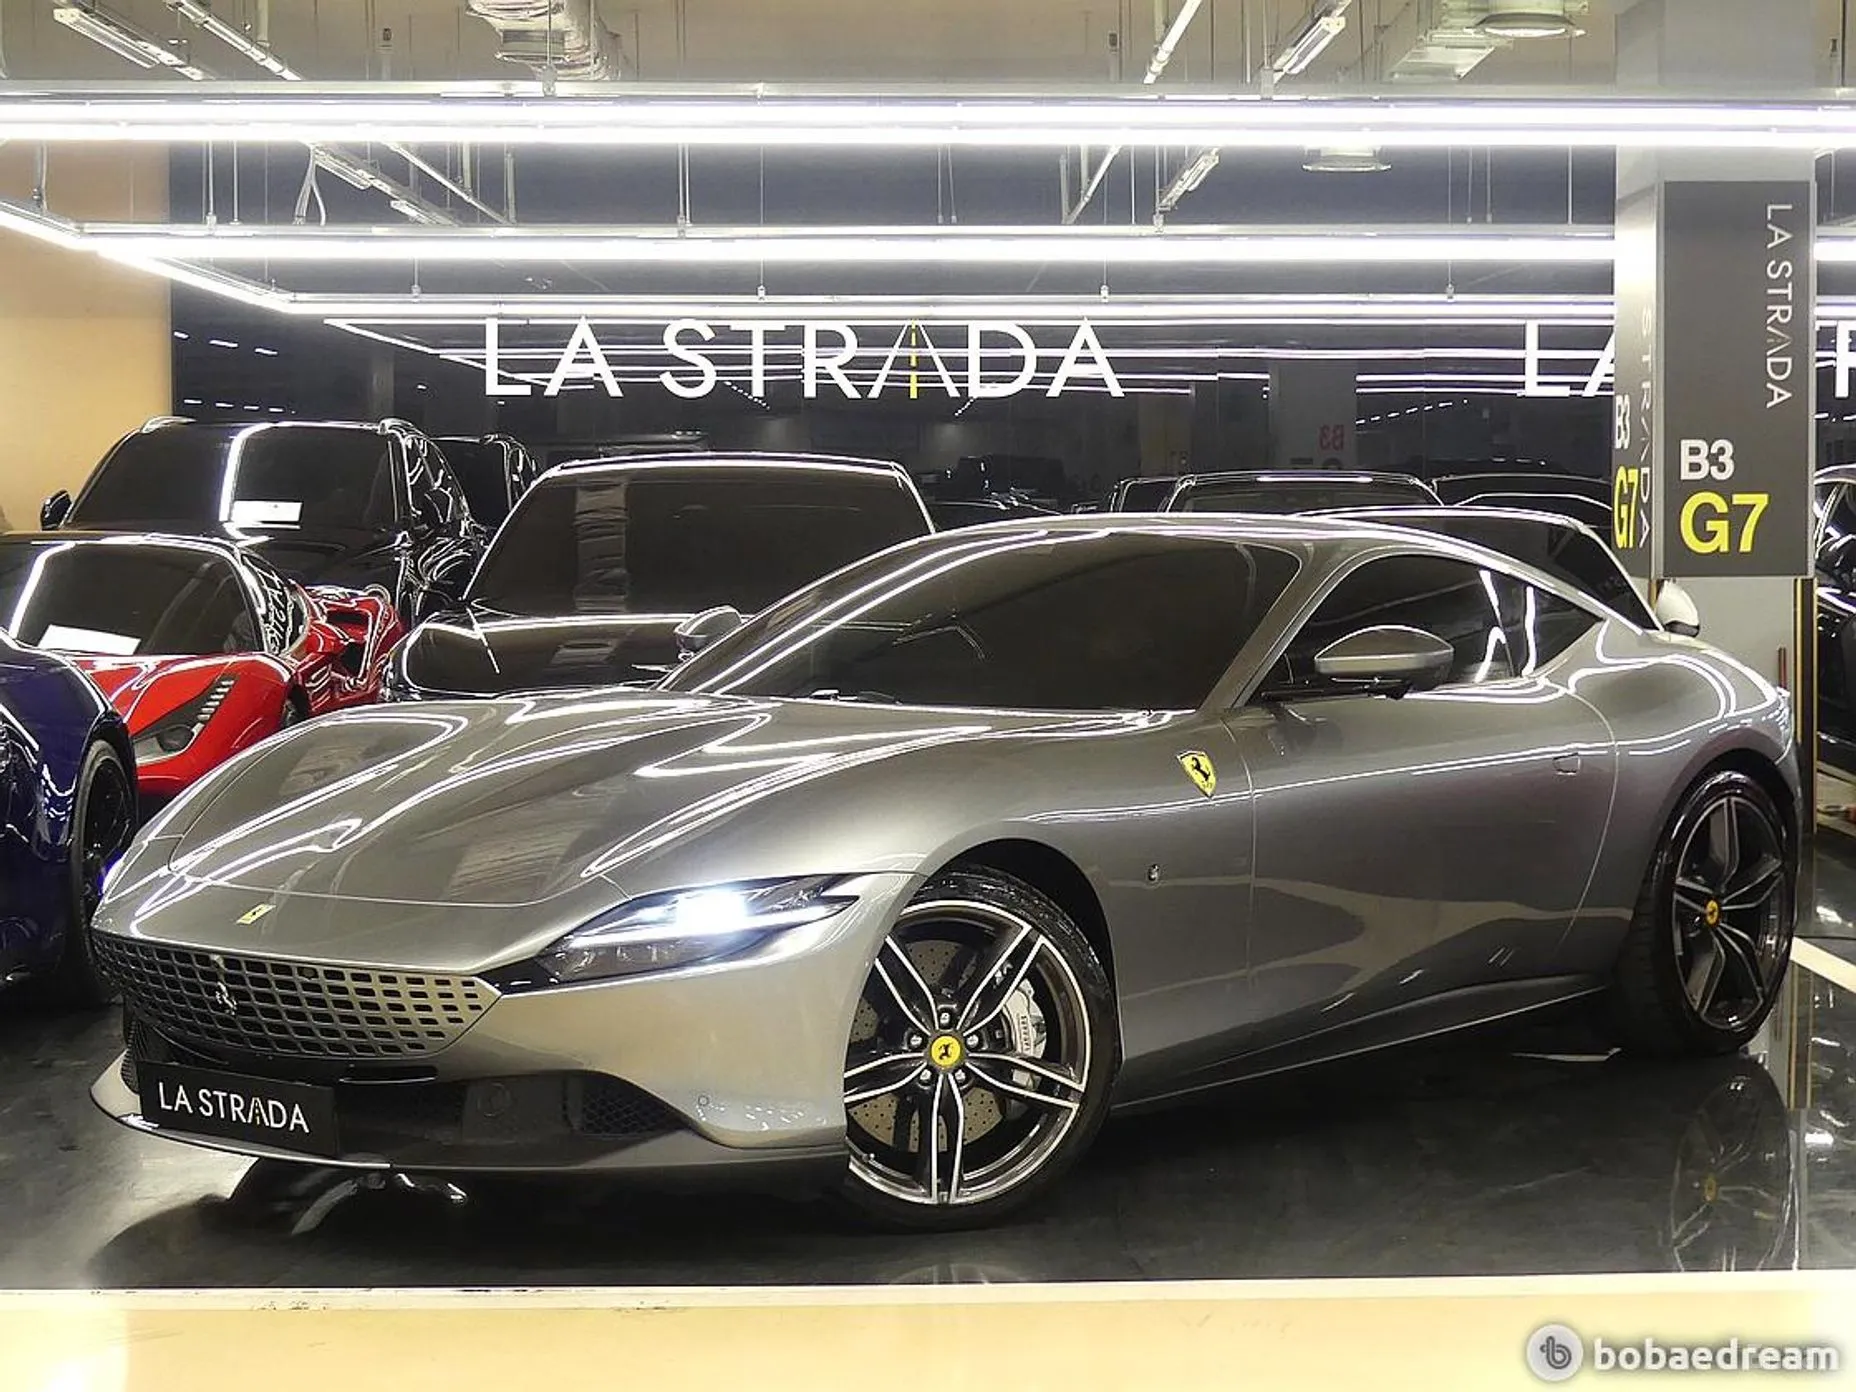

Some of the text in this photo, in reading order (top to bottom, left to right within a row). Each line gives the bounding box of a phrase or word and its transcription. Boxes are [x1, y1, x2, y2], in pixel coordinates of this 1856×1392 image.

[1767, 204, 1793, 408] LA STRADA
[485, 317, 1124, 398] LA STRADA
[1680, 439, 1735, 481] B3
[1613, 466, 1639, 548] G7
[1680, 491, 1769, 554] G7
[158, 1081, 310, 1134] LA STRADA
